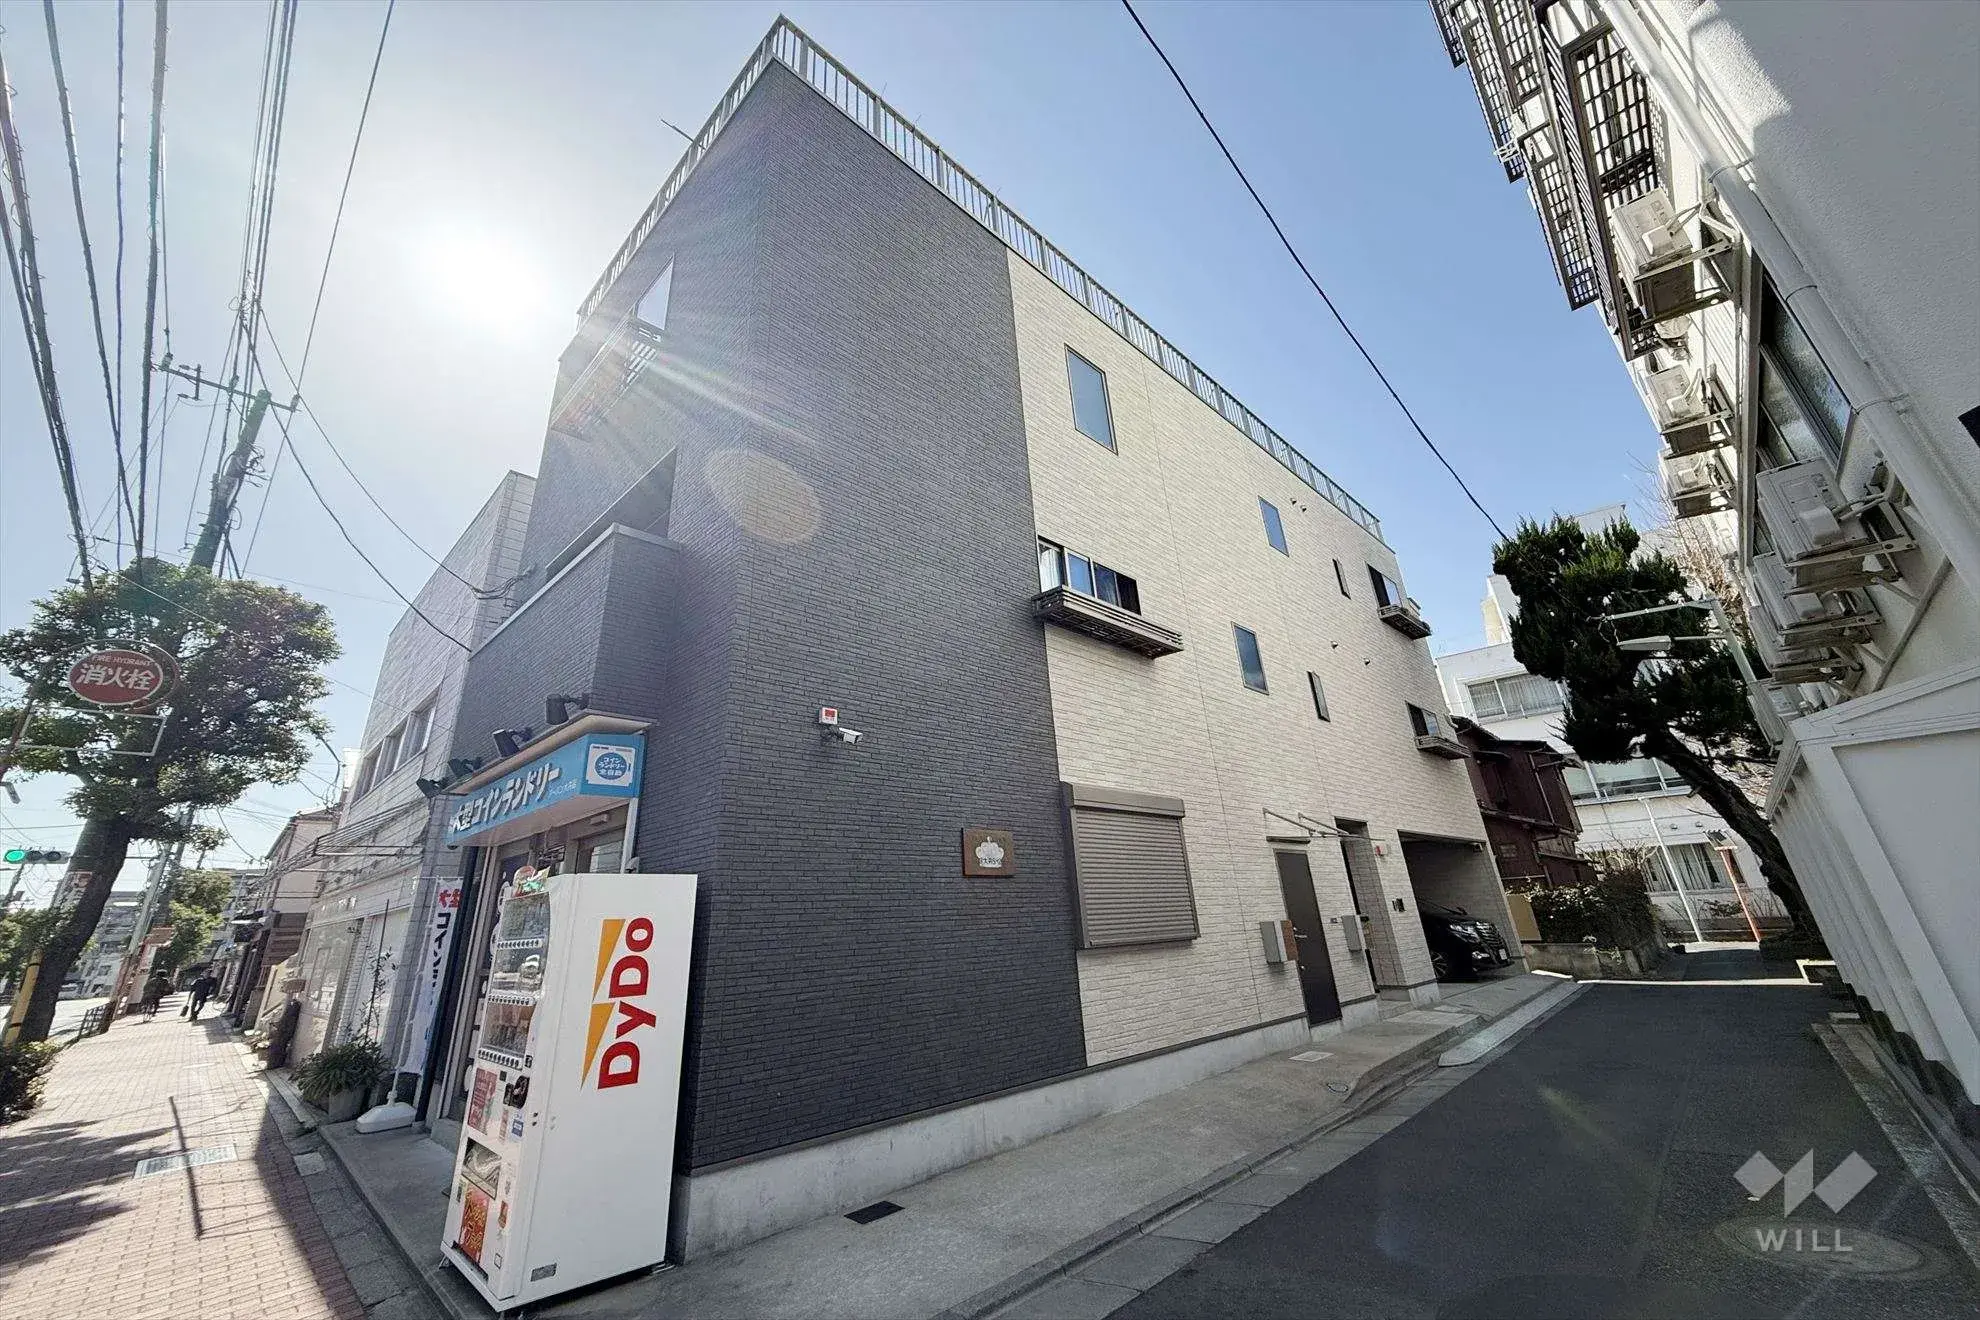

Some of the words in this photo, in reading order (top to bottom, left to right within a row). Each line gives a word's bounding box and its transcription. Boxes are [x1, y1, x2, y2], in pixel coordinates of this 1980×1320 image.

[75, 663, 155, 691] 消火栓
[91, 655, 111, 664] FIRE
[113, 657, 152, 667] HYDRANT
[450, 763, 561, 832] 大型コインランドリー
[597, 916, 656, 1090] DyDo
